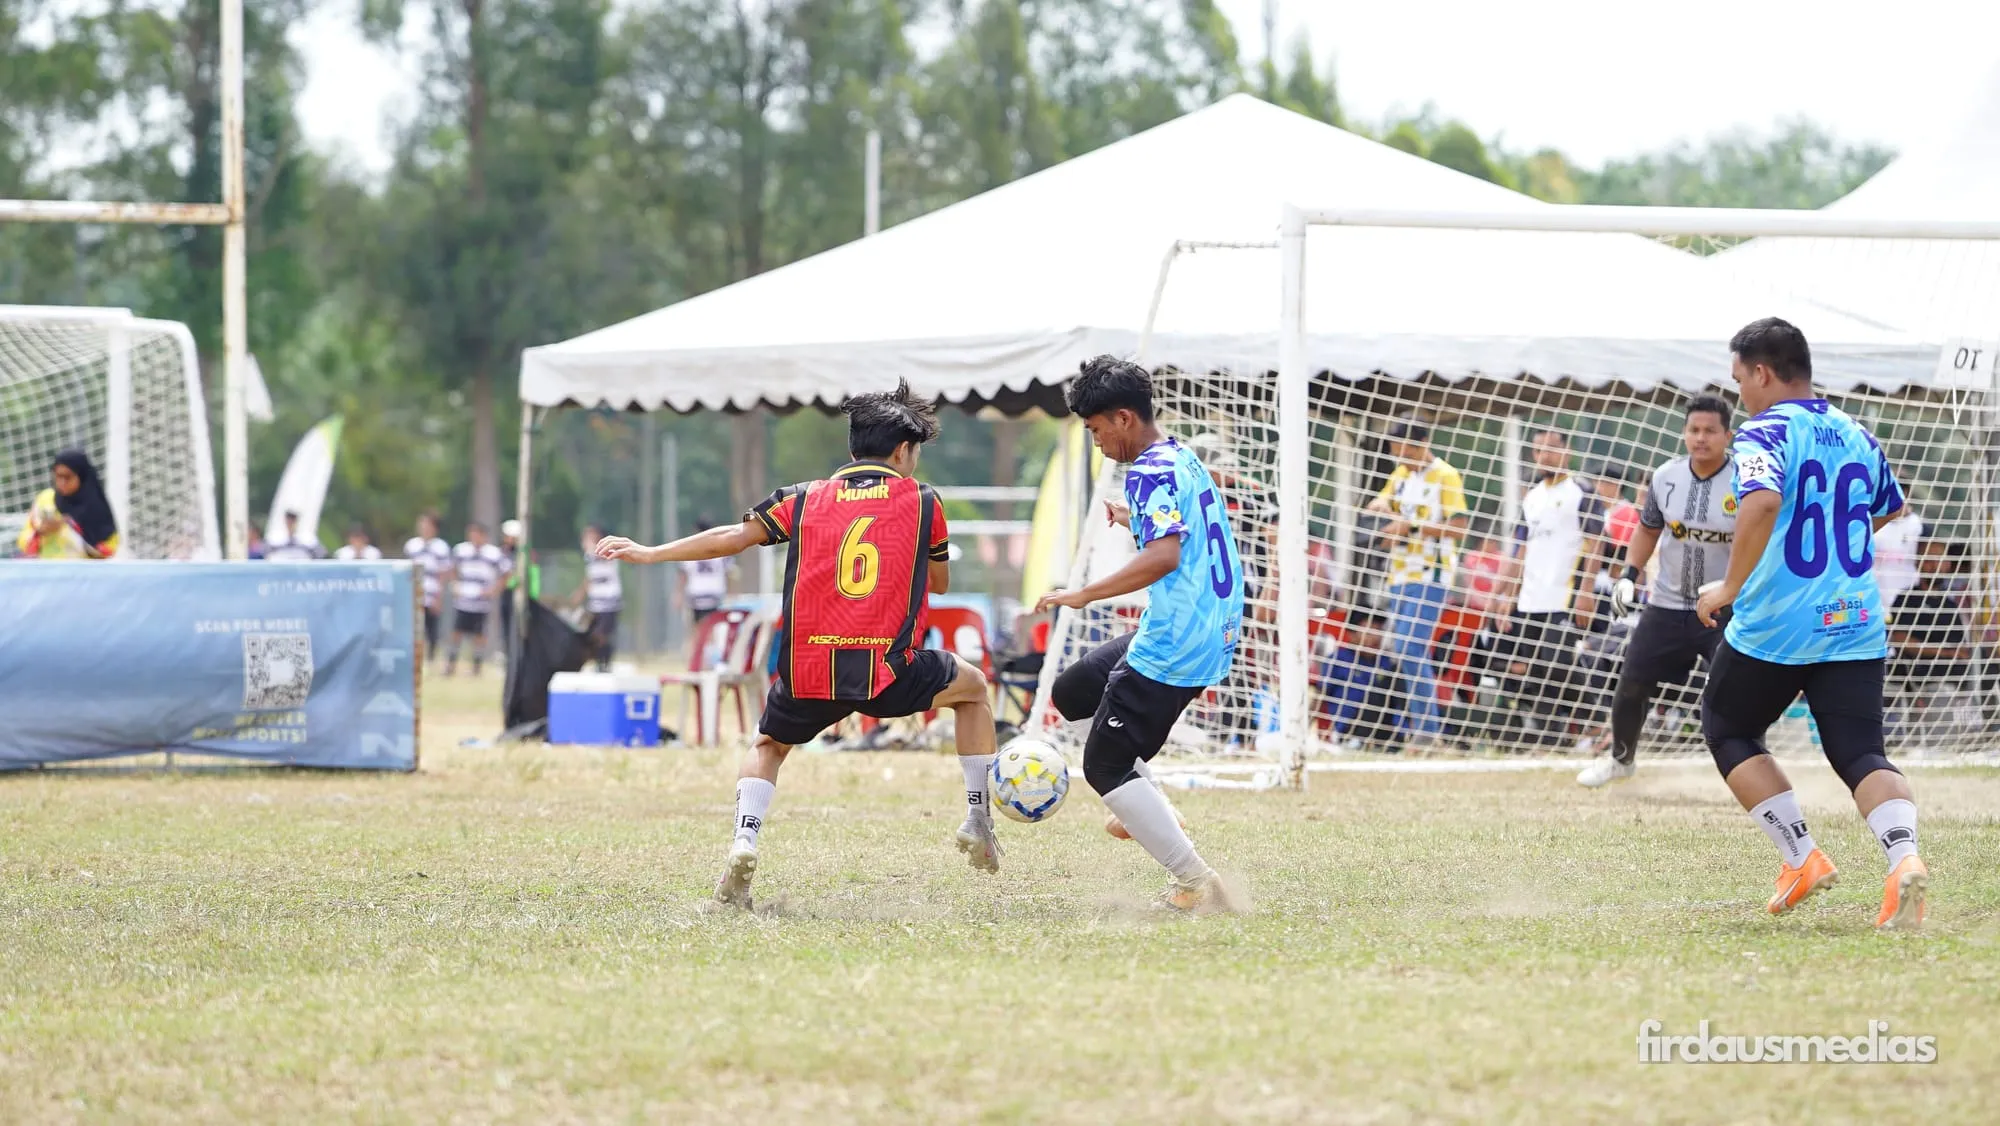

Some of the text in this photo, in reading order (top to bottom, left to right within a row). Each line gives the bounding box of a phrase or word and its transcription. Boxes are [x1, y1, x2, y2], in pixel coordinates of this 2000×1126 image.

[1748, 465, 1765, 477] 25
[836, 485, 889, 503] MUNIR
[1664, 482, 1676, 508] 7
[1784, 459, 1875, 578] 66
[1199, 488, 1233, 599] 5
[835, 515, 880, 600] 6
[232, 618, 261, 632] FOR
[807, 635, 896, 647] MSZSportswea
[742, 816, 761, 832] FS
